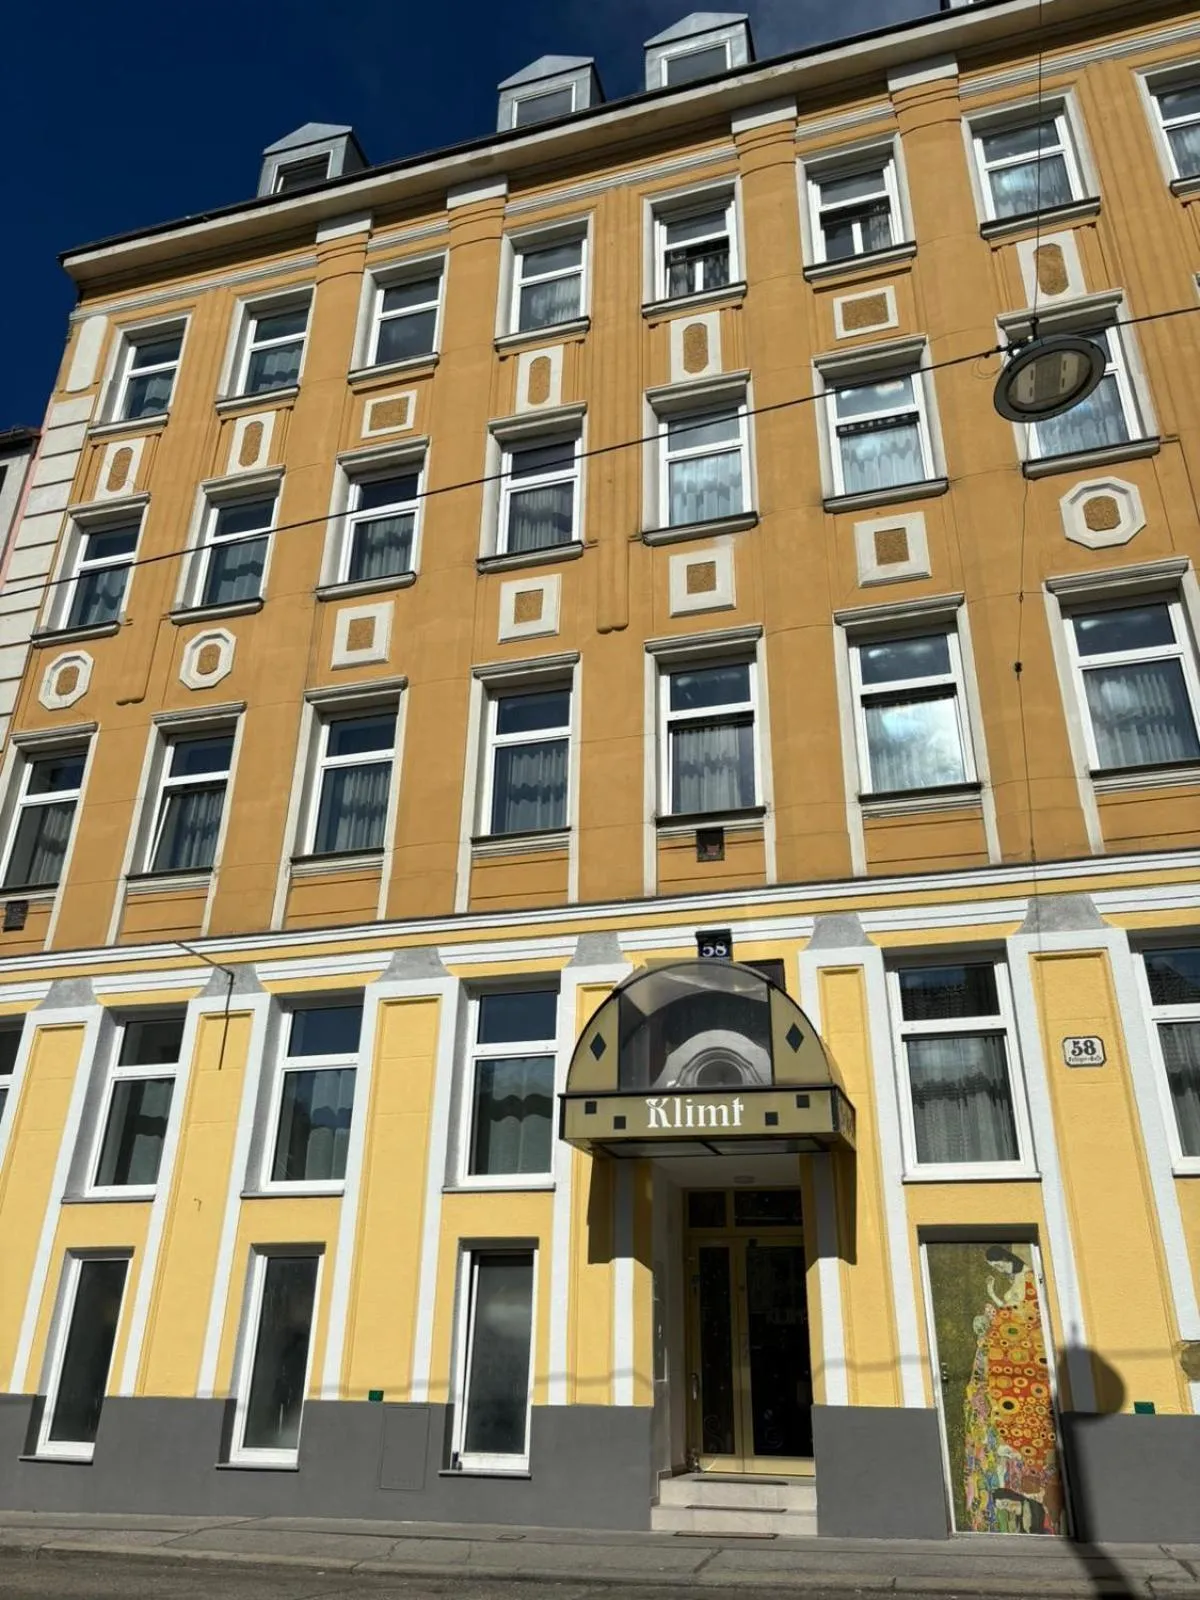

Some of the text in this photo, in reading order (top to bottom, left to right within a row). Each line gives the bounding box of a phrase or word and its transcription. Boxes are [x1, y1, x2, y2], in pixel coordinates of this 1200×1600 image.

[702, 942, 727, 957] 58
[1071, 1040, 1097, 1056] 58
[645, 1097, 744, 1128] Klimt
